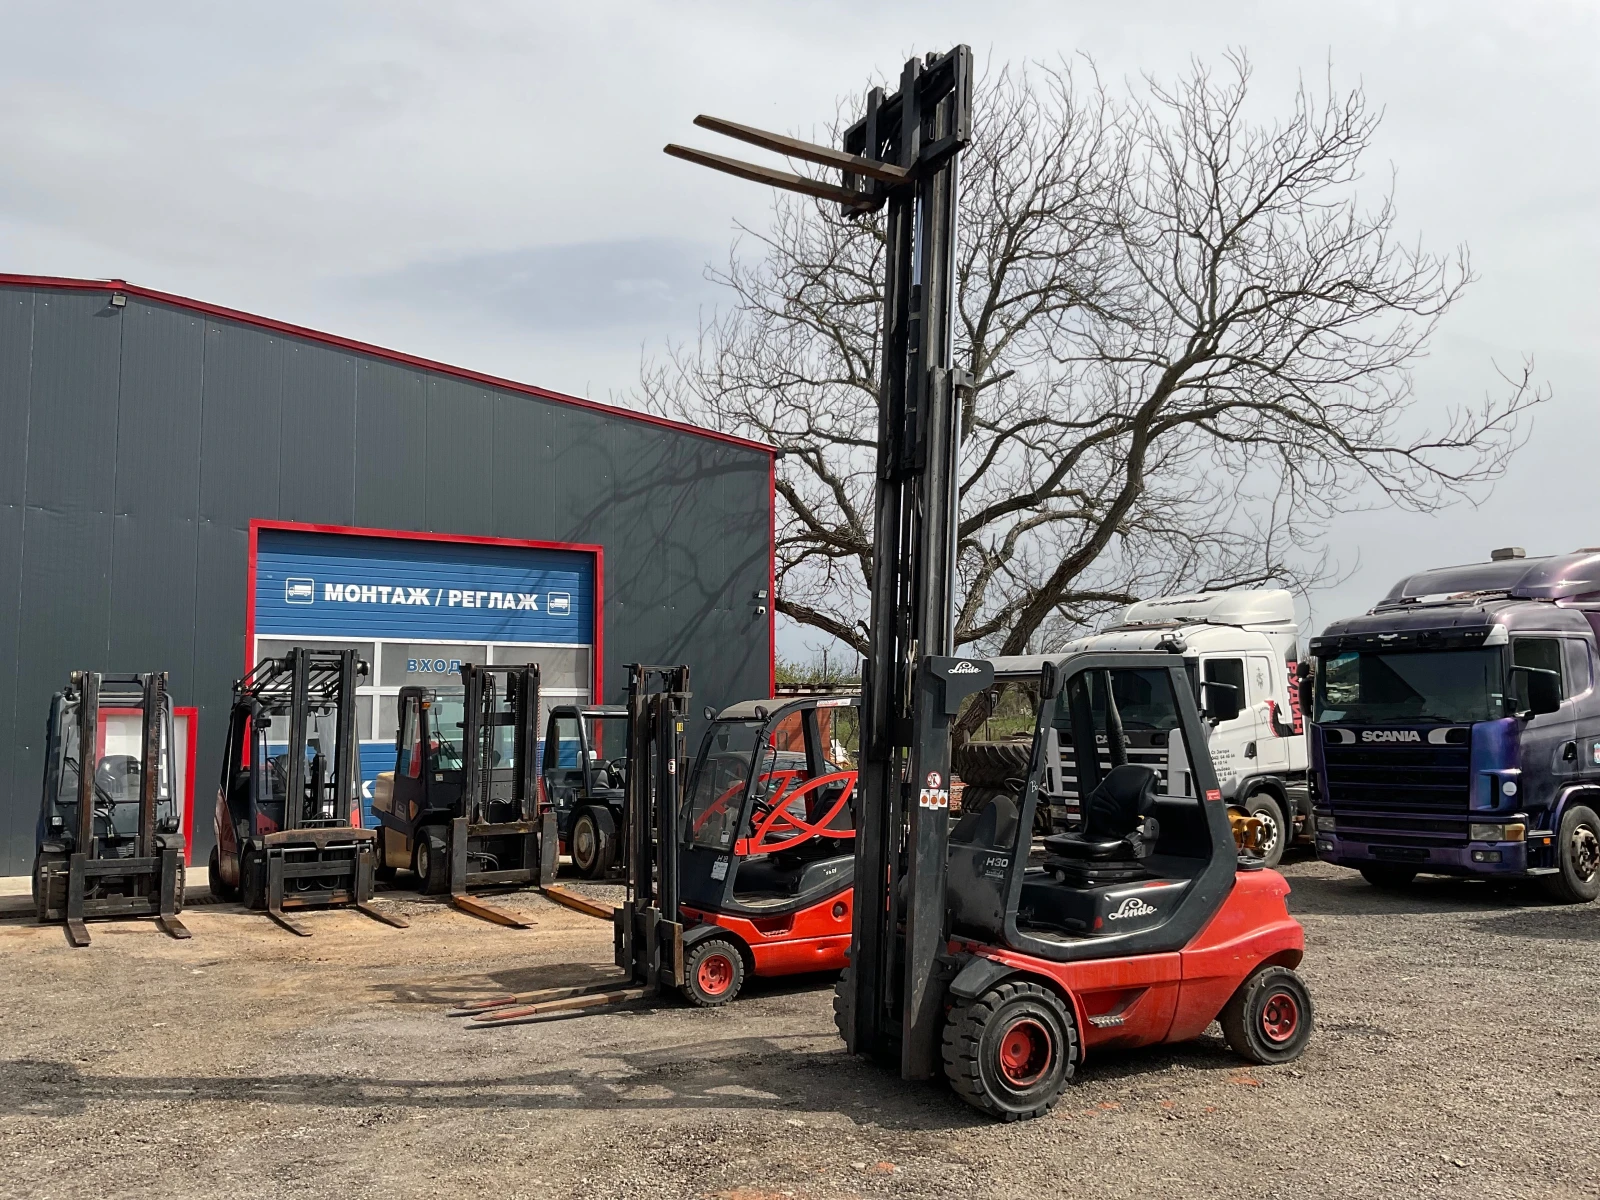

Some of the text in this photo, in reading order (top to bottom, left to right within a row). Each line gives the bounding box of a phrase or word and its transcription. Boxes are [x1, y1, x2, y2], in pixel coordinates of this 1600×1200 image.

[324, 583, 539, 611] МОНТАЖ / РЕГЛАЖ
[406, 657, 462, 675] ВХОД
[947, 661, 982, 674] Linde
[1286, 660, 1303, 736] РУДИН
[1361, 730, 1421, 742] SCANIA
[985, 857, 1009, 868] H30
[1108, 897, 1158, 920] Linde
